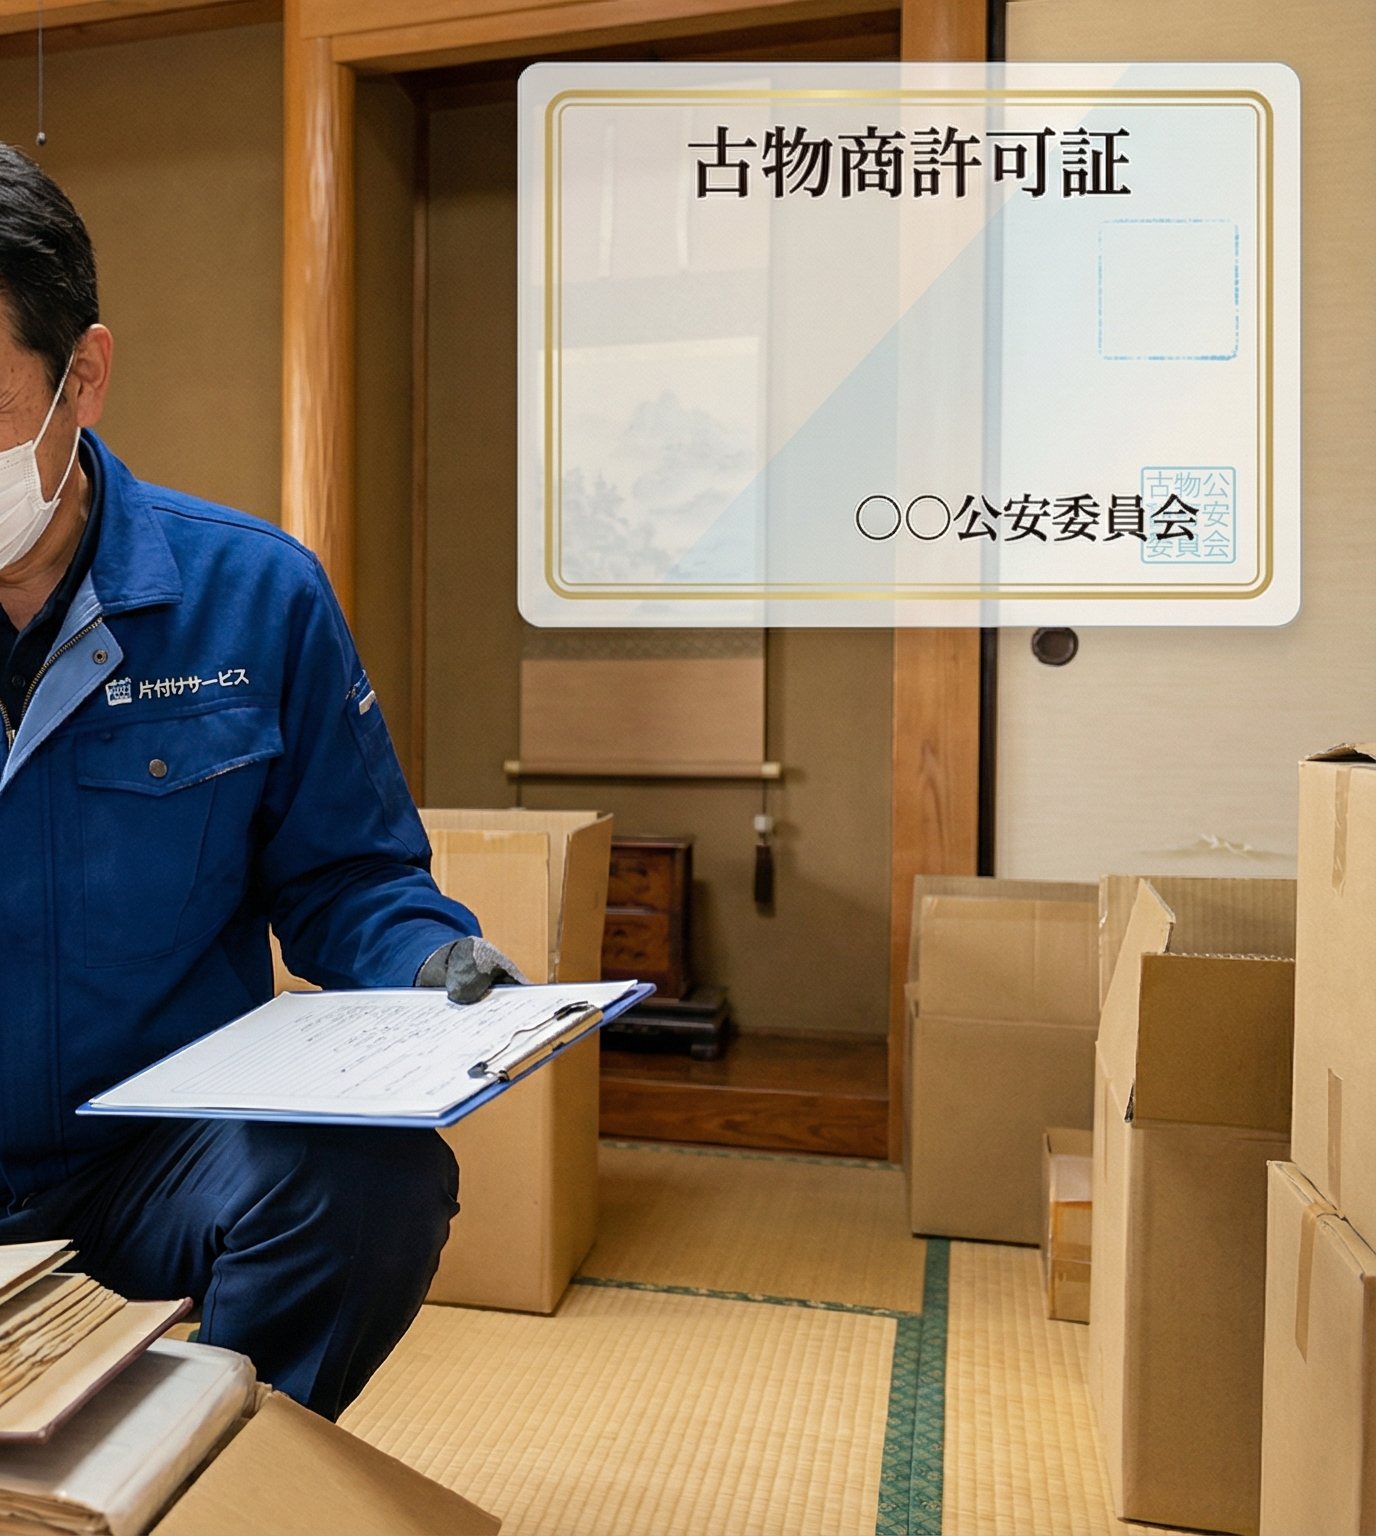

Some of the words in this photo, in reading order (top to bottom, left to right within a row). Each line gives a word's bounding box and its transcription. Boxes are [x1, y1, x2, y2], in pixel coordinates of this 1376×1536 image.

[138, 668, 250, 699] 片付けサービス
